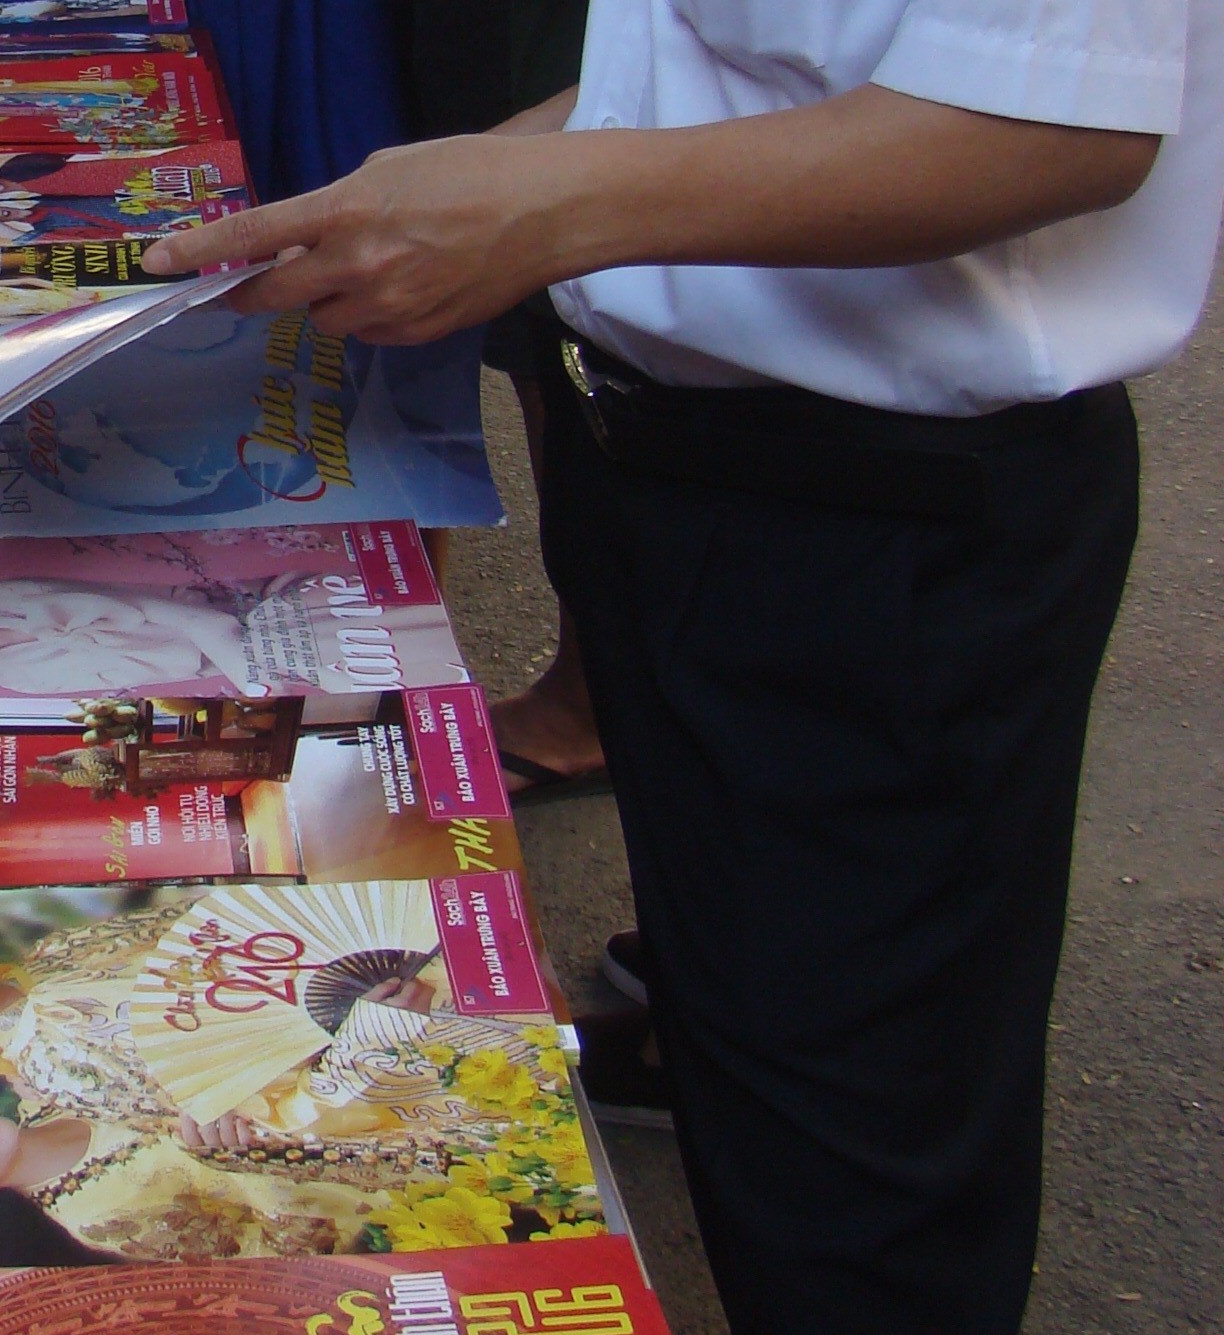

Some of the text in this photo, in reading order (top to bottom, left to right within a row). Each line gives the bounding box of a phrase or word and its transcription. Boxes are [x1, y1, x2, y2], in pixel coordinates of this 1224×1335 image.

[302, 400, 356, 488] năm
[391, 579, 410, 595] BÁO
[439, 702, 460, 721] BÀY
[444, 721, 467, 754] TRƯNG
[356, 726, 376, 772] CHUNG TAY
[376, 749, 396, 771] CUỘC
[1, 765, 17, 784] GÒN
[448, 754, 471, 780] XUÂN
[1, 785, 16, 804] SÀI
[380, 772, 399, 796] DỰNG
[453, 781, 476, 802] BÁO
[383, 796, 401, 814] XÂY
[469, 891, 492, 913] BÀY
[474, 914, 499, 947] TRƯNG
[479, 947, 503, 975] XUÂN
[486, 975, 511, 998] BÁO
